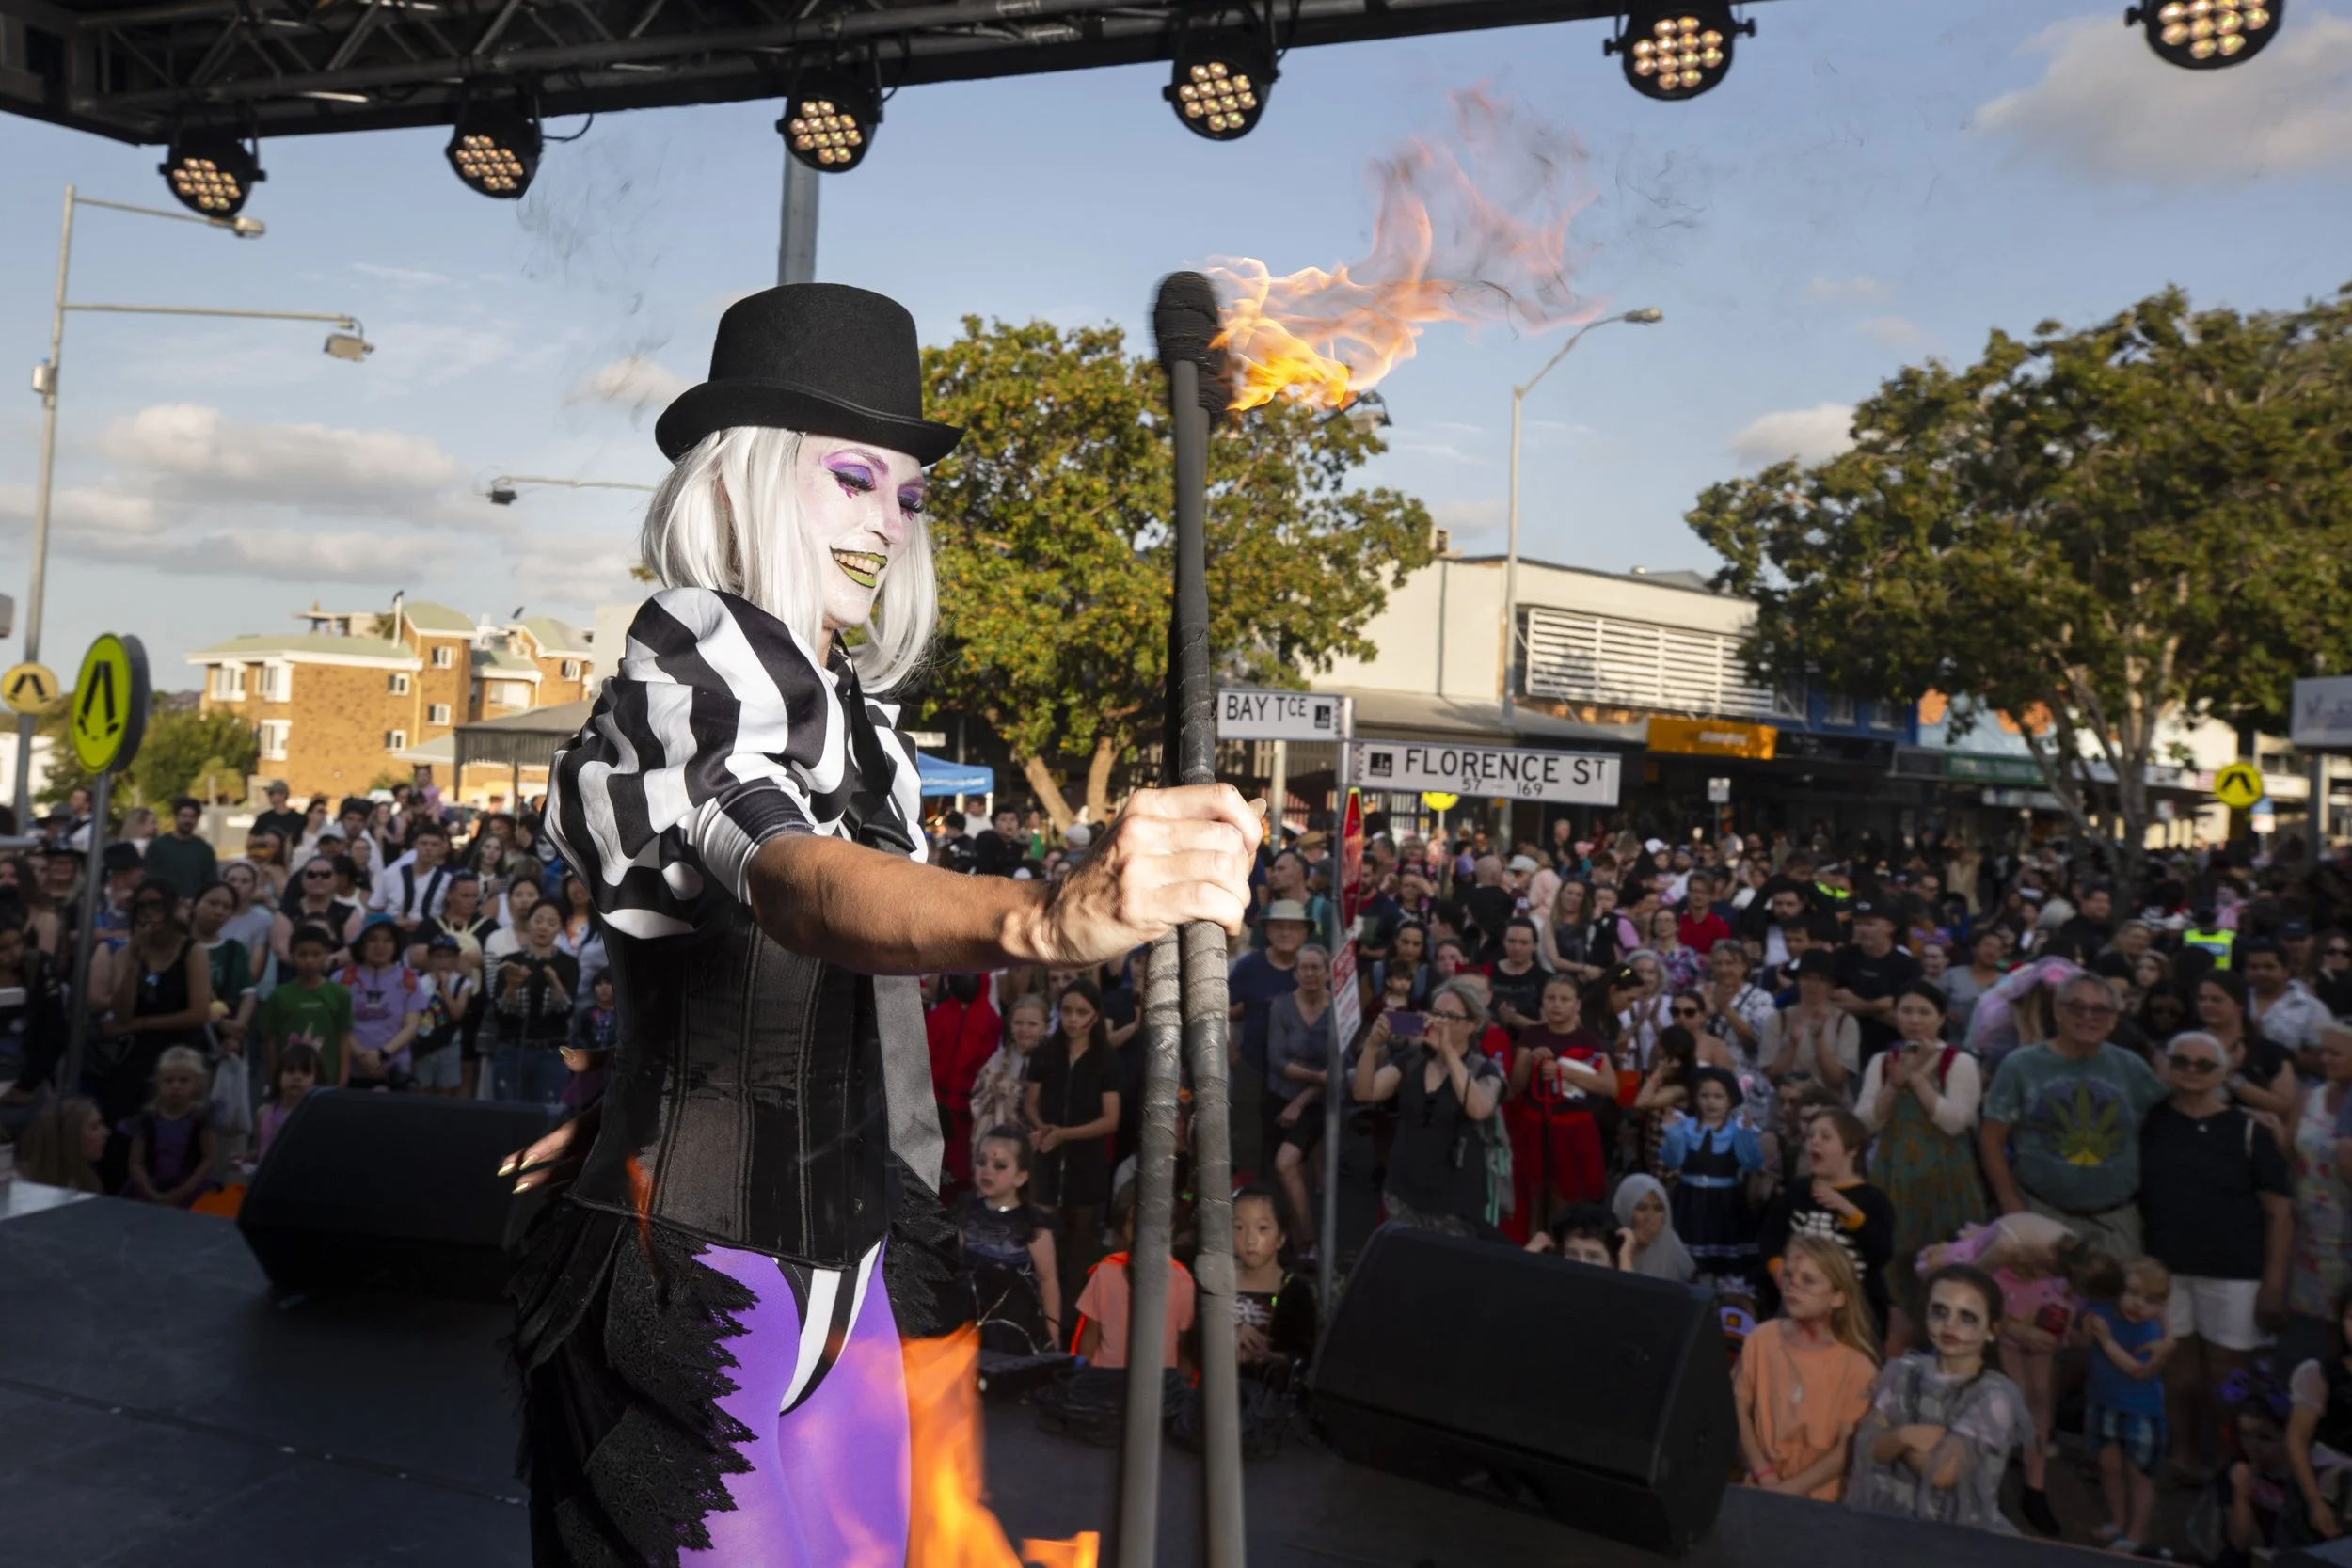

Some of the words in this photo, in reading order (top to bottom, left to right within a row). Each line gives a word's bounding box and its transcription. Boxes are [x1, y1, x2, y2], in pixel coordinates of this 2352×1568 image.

[1226, 695, 1269, 721] BAY
[1275, 696, 1307, 721] TCE
[1406, 749, 1560, 784] FLORENCE
[1572, 756, 1607, 785] ST
[1462, 778, 1482, 792] 57
[1516, 782, 1543, 797] 169
